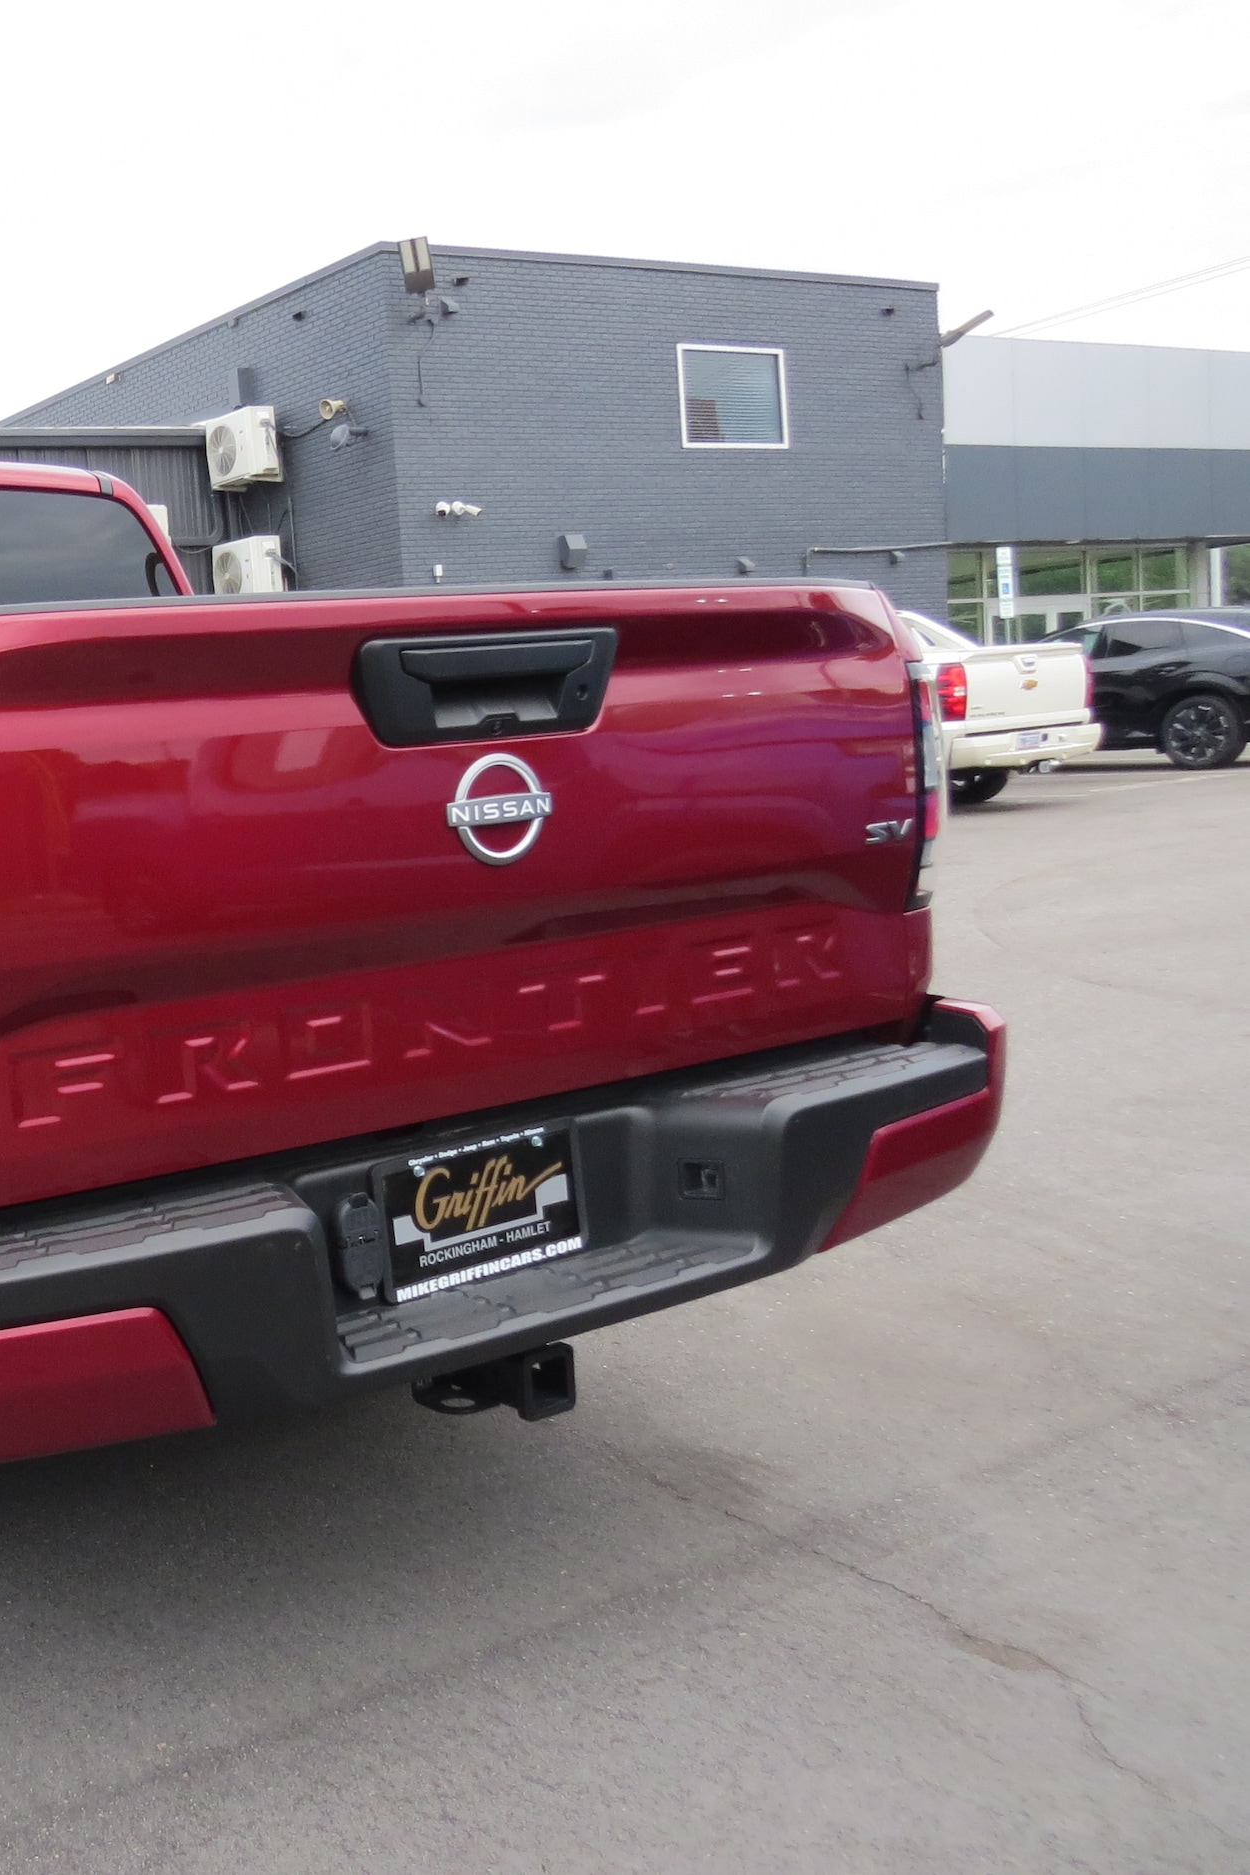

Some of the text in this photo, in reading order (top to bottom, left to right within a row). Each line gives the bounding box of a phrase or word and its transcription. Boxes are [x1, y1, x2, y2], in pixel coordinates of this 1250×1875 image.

[451, 798, 550, 823] NISSAN
[865, 818, 913, 845] SV
[12, 921, 843, 1128] FRONTIER
[414, 1154, 563, 1231] Griffin
[396, 1236, 583, 1302] MIKEGRIFFINCARS.COM
[419, 1236, 498, 1268] ROCKINGHAM
[506, 1220, 552, 1243] HAMLET
